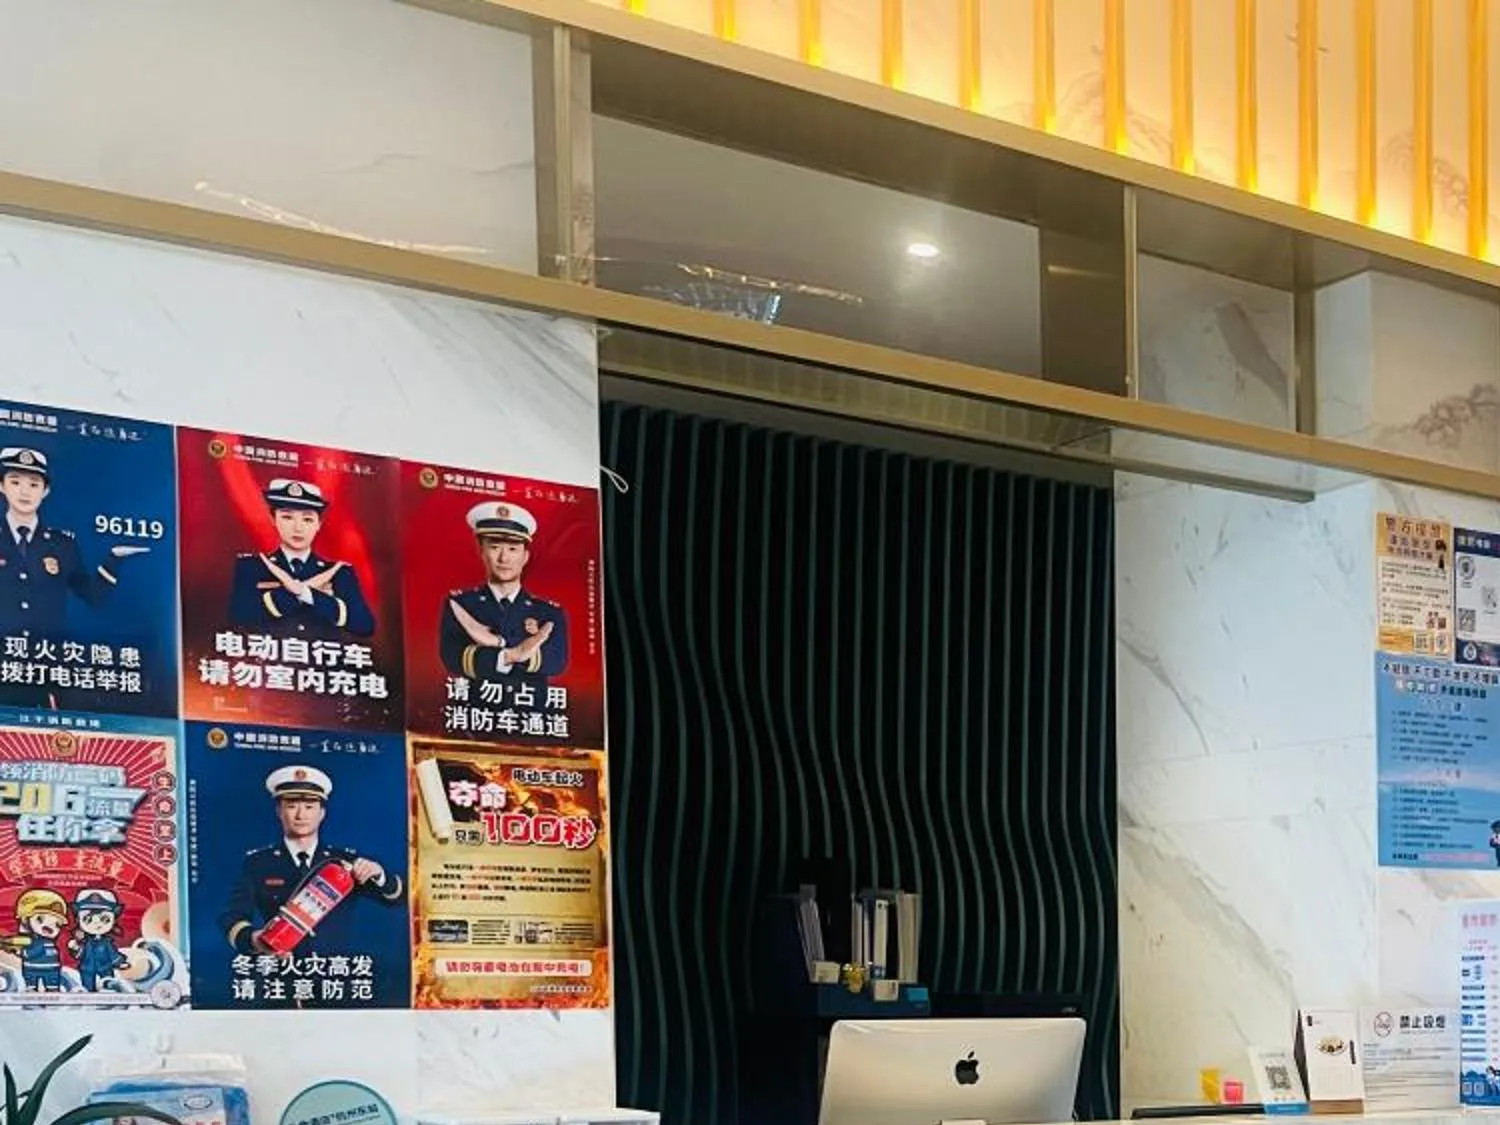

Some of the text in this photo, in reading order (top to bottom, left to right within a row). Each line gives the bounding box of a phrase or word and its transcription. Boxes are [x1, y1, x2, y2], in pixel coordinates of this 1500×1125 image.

[95, 515, 163, 539] 96119
[5, 637, 141, 668] 现火灾隐患
[215, 631, 373, 669] 电动自行车
[1, 661, 142, 693] 拨打电话举报
[198, 659, 389, 699] 请勿室内充电
[445, 676, 567, 709] 请勿占用
[445, 705, 569, 737] 消防车通道
[482, 811, 597, 848] 100秒
[231, 954, 373, 977] 冬季火灾高发
[231, 979, 373, 1000] 请注意防范
[1399, 1015, 1446, 1029] 禁止吸烟
